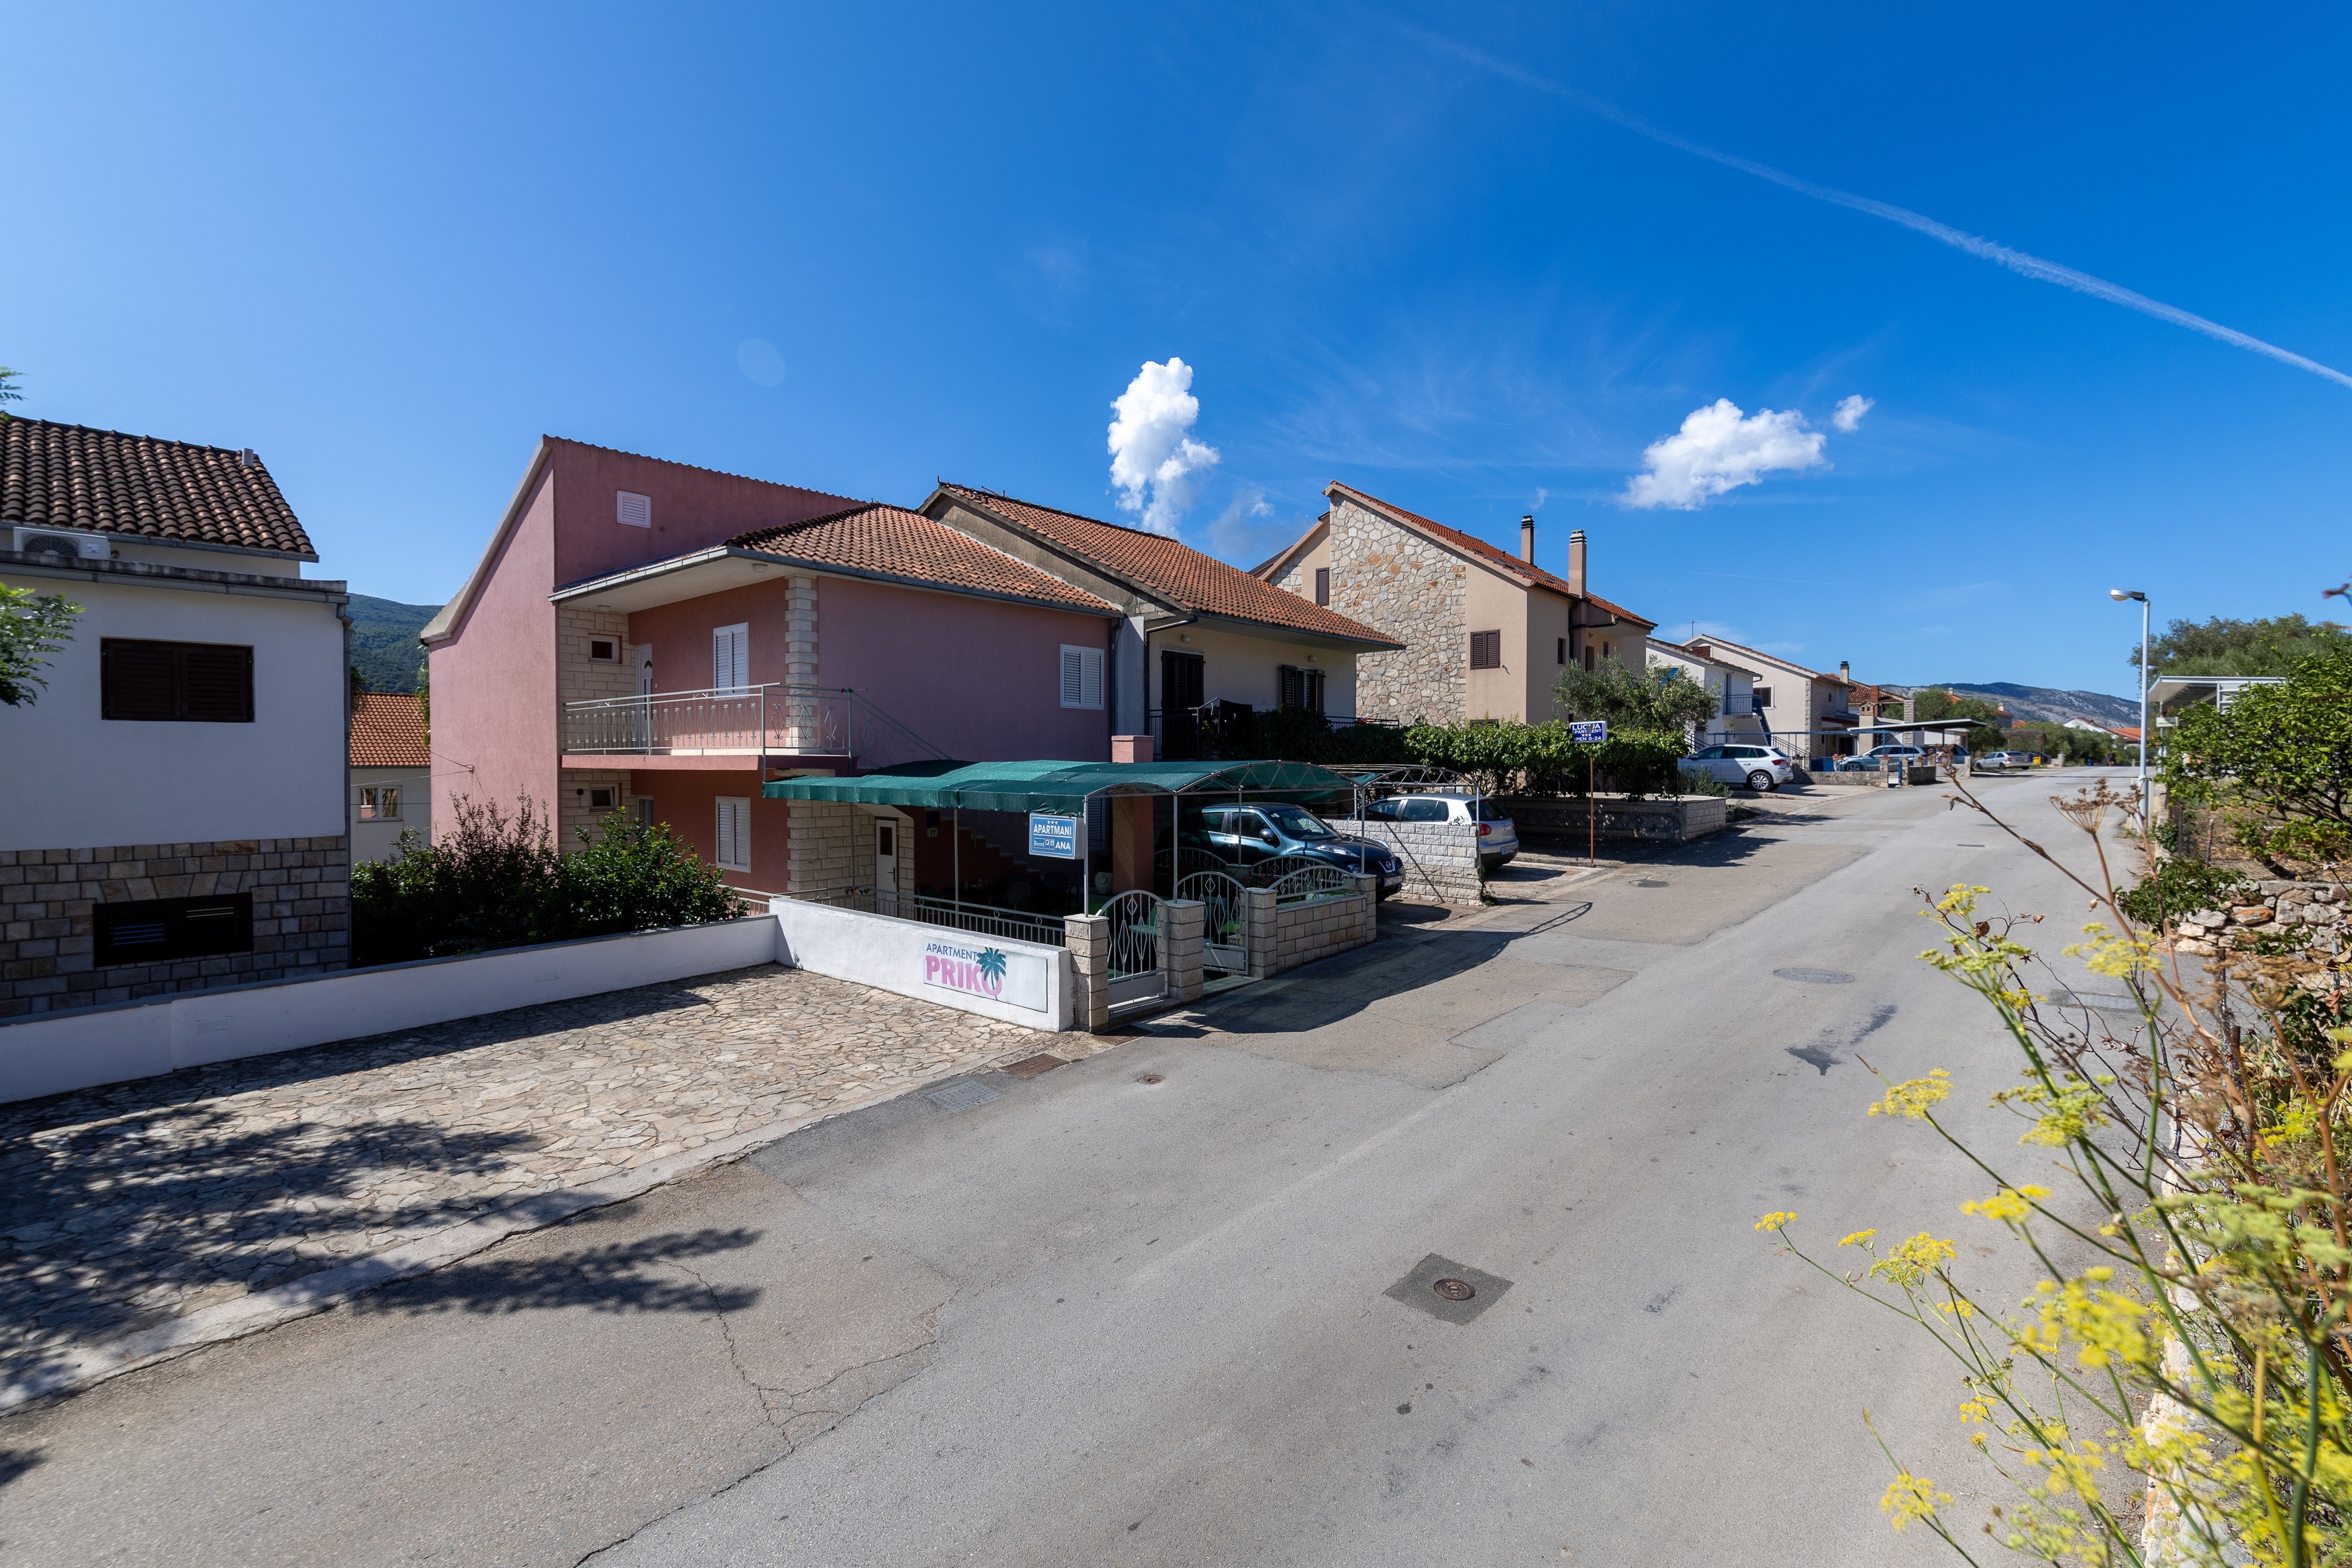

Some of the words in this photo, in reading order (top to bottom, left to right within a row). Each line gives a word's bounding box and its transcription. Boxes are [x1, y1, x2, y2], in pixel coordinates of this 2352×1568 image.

[1033, 824, 1072, 836] APARTMANI
[1055, 841, 1071, 850] ANA
[926, 955, 1003, 997] PRIKO
